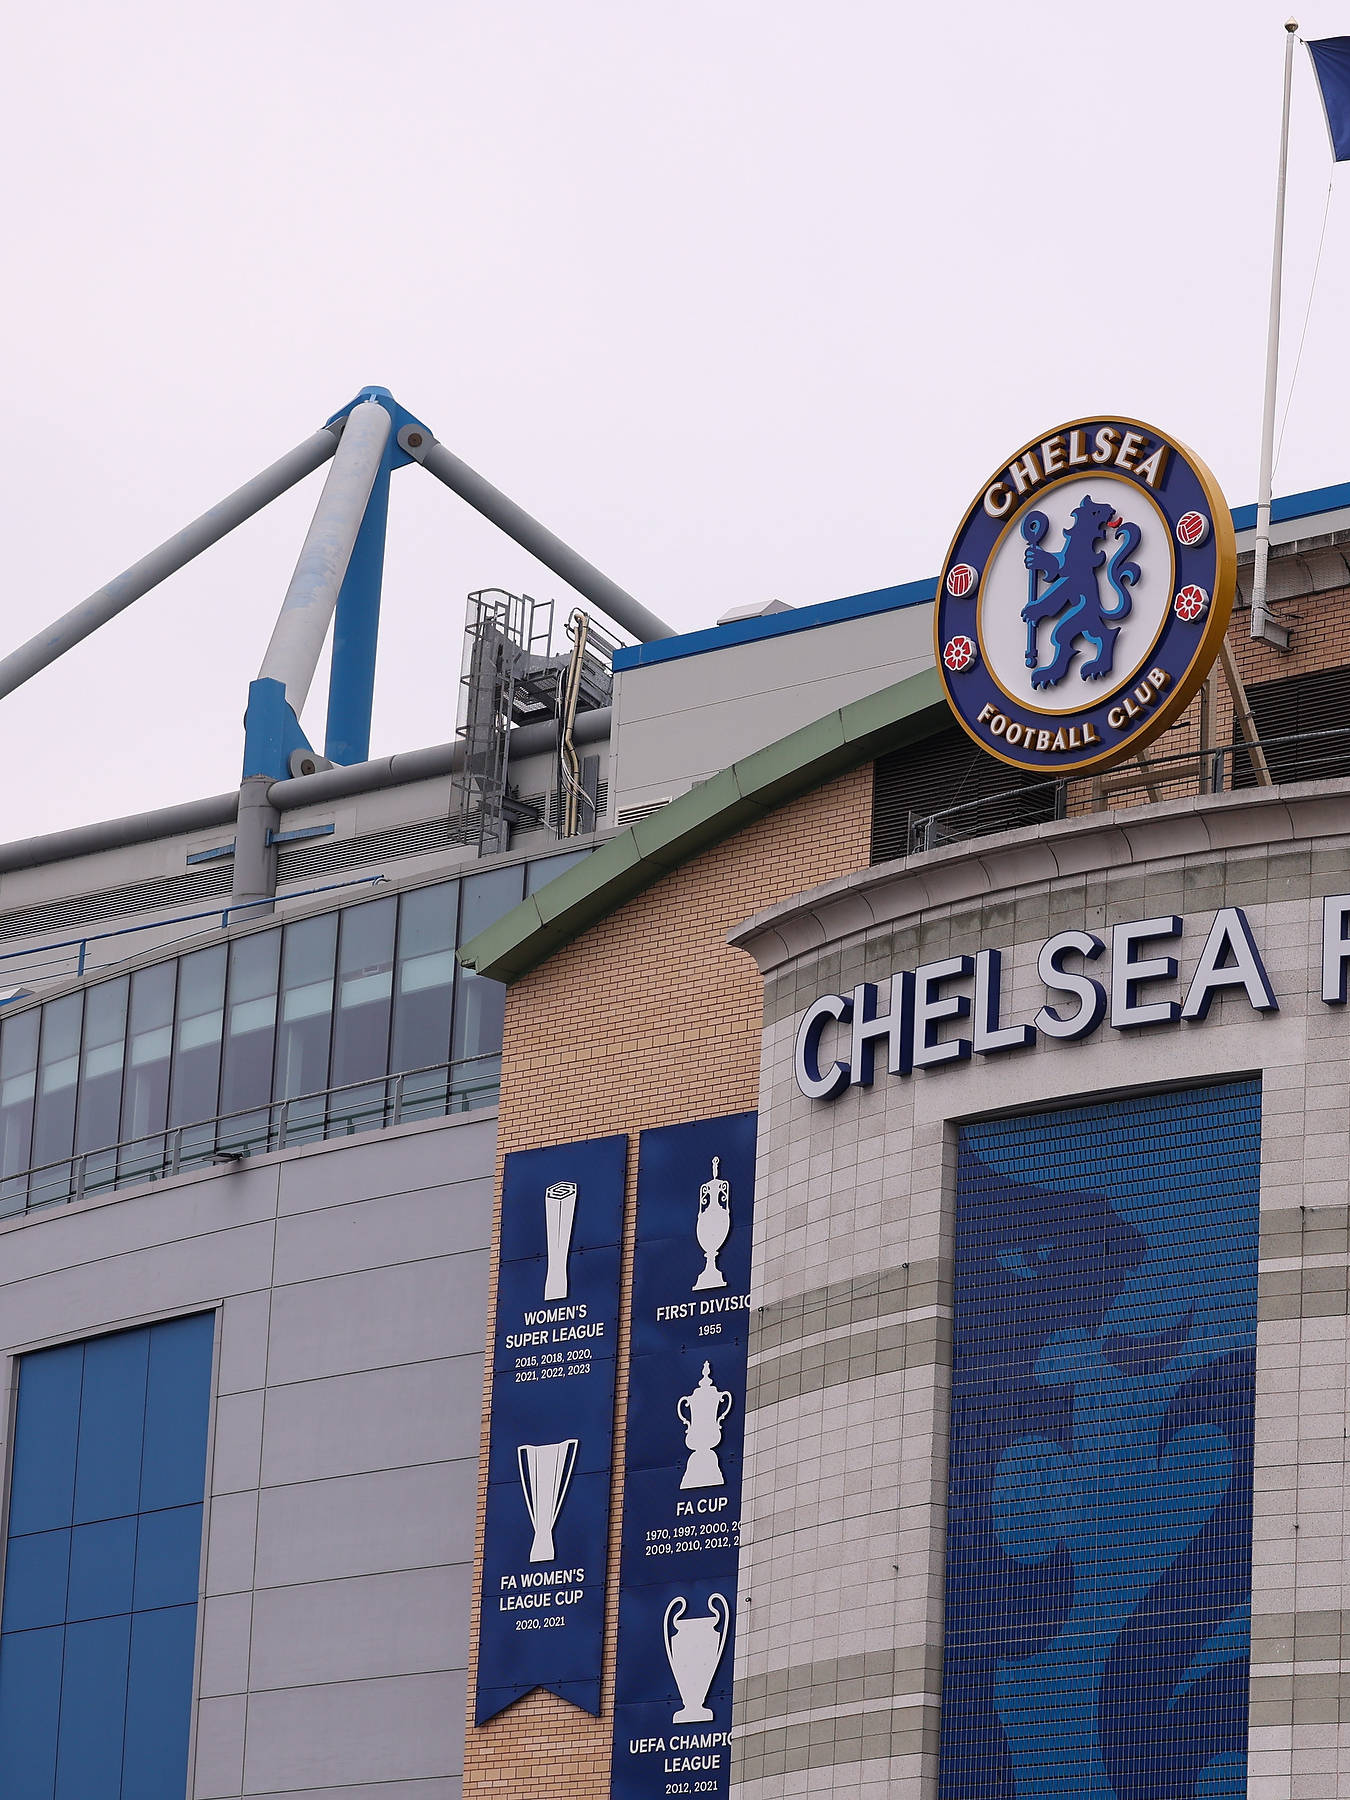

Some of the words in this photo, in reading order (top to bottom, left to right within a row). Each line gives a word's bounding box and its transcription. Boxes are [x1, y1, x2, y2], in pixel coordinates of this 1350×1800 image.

[983, 426, 1168, 518] CHELSEA
[976, 702, 1101, 752] FOOTBALL
[1106, 667, 1172, 730] CLUB
[794, 906, 1281, 1101] CHELSEA
[524, 1304, 587, 1326] WOMEN'S
[656, 1302, 697, 1322] FIRST
[505, 1330, 549, 1349] SUPER
[552, 1322, 604, 1343] LEAGUE
[698, 1323, 722, 1337] 1955
[514, 1355, 539, 1369] 2015,
[540, 1352, 565, 1365] 2018,
[566, 1348, 593, 1362] 2020,
[515, 1370, 539, 1383] 2021,
[540, 1366, 566, 1379] 2022,
[567, 1363, 591, 1376] 2023
[676, 1500, 694, 1517] FA
[696, 1496, 728, 1514] CUP
[645, 1528, 671, 1541] 1970,
[672, 1525, 698, 1538] 1997,
[699, 1522, 730, 1535] 2000,
[645, 1543, 674, 1556] 2009,
[675, 1539, 703, 1553] 2010,
[704, 1536, 731, 1549] 2012,
[500, 1575, 518, 1590] FA
[520, 1568, 585, 1588] WOMEN'S
[499, 1592, 552, 1612] LEAGUE
[554, 1589, 584, 1606] CUP
[515, 1618, 542, 1631] 2020,
[543, 1616, 566, 1628] 2021
[629, 1737, 666, 1754] UEFA
[664, 1754, 721, 1773] LEAGUE
[665, 1782, 692, 1795] 2012,
[694, 1780, 718, 1793] 2021
